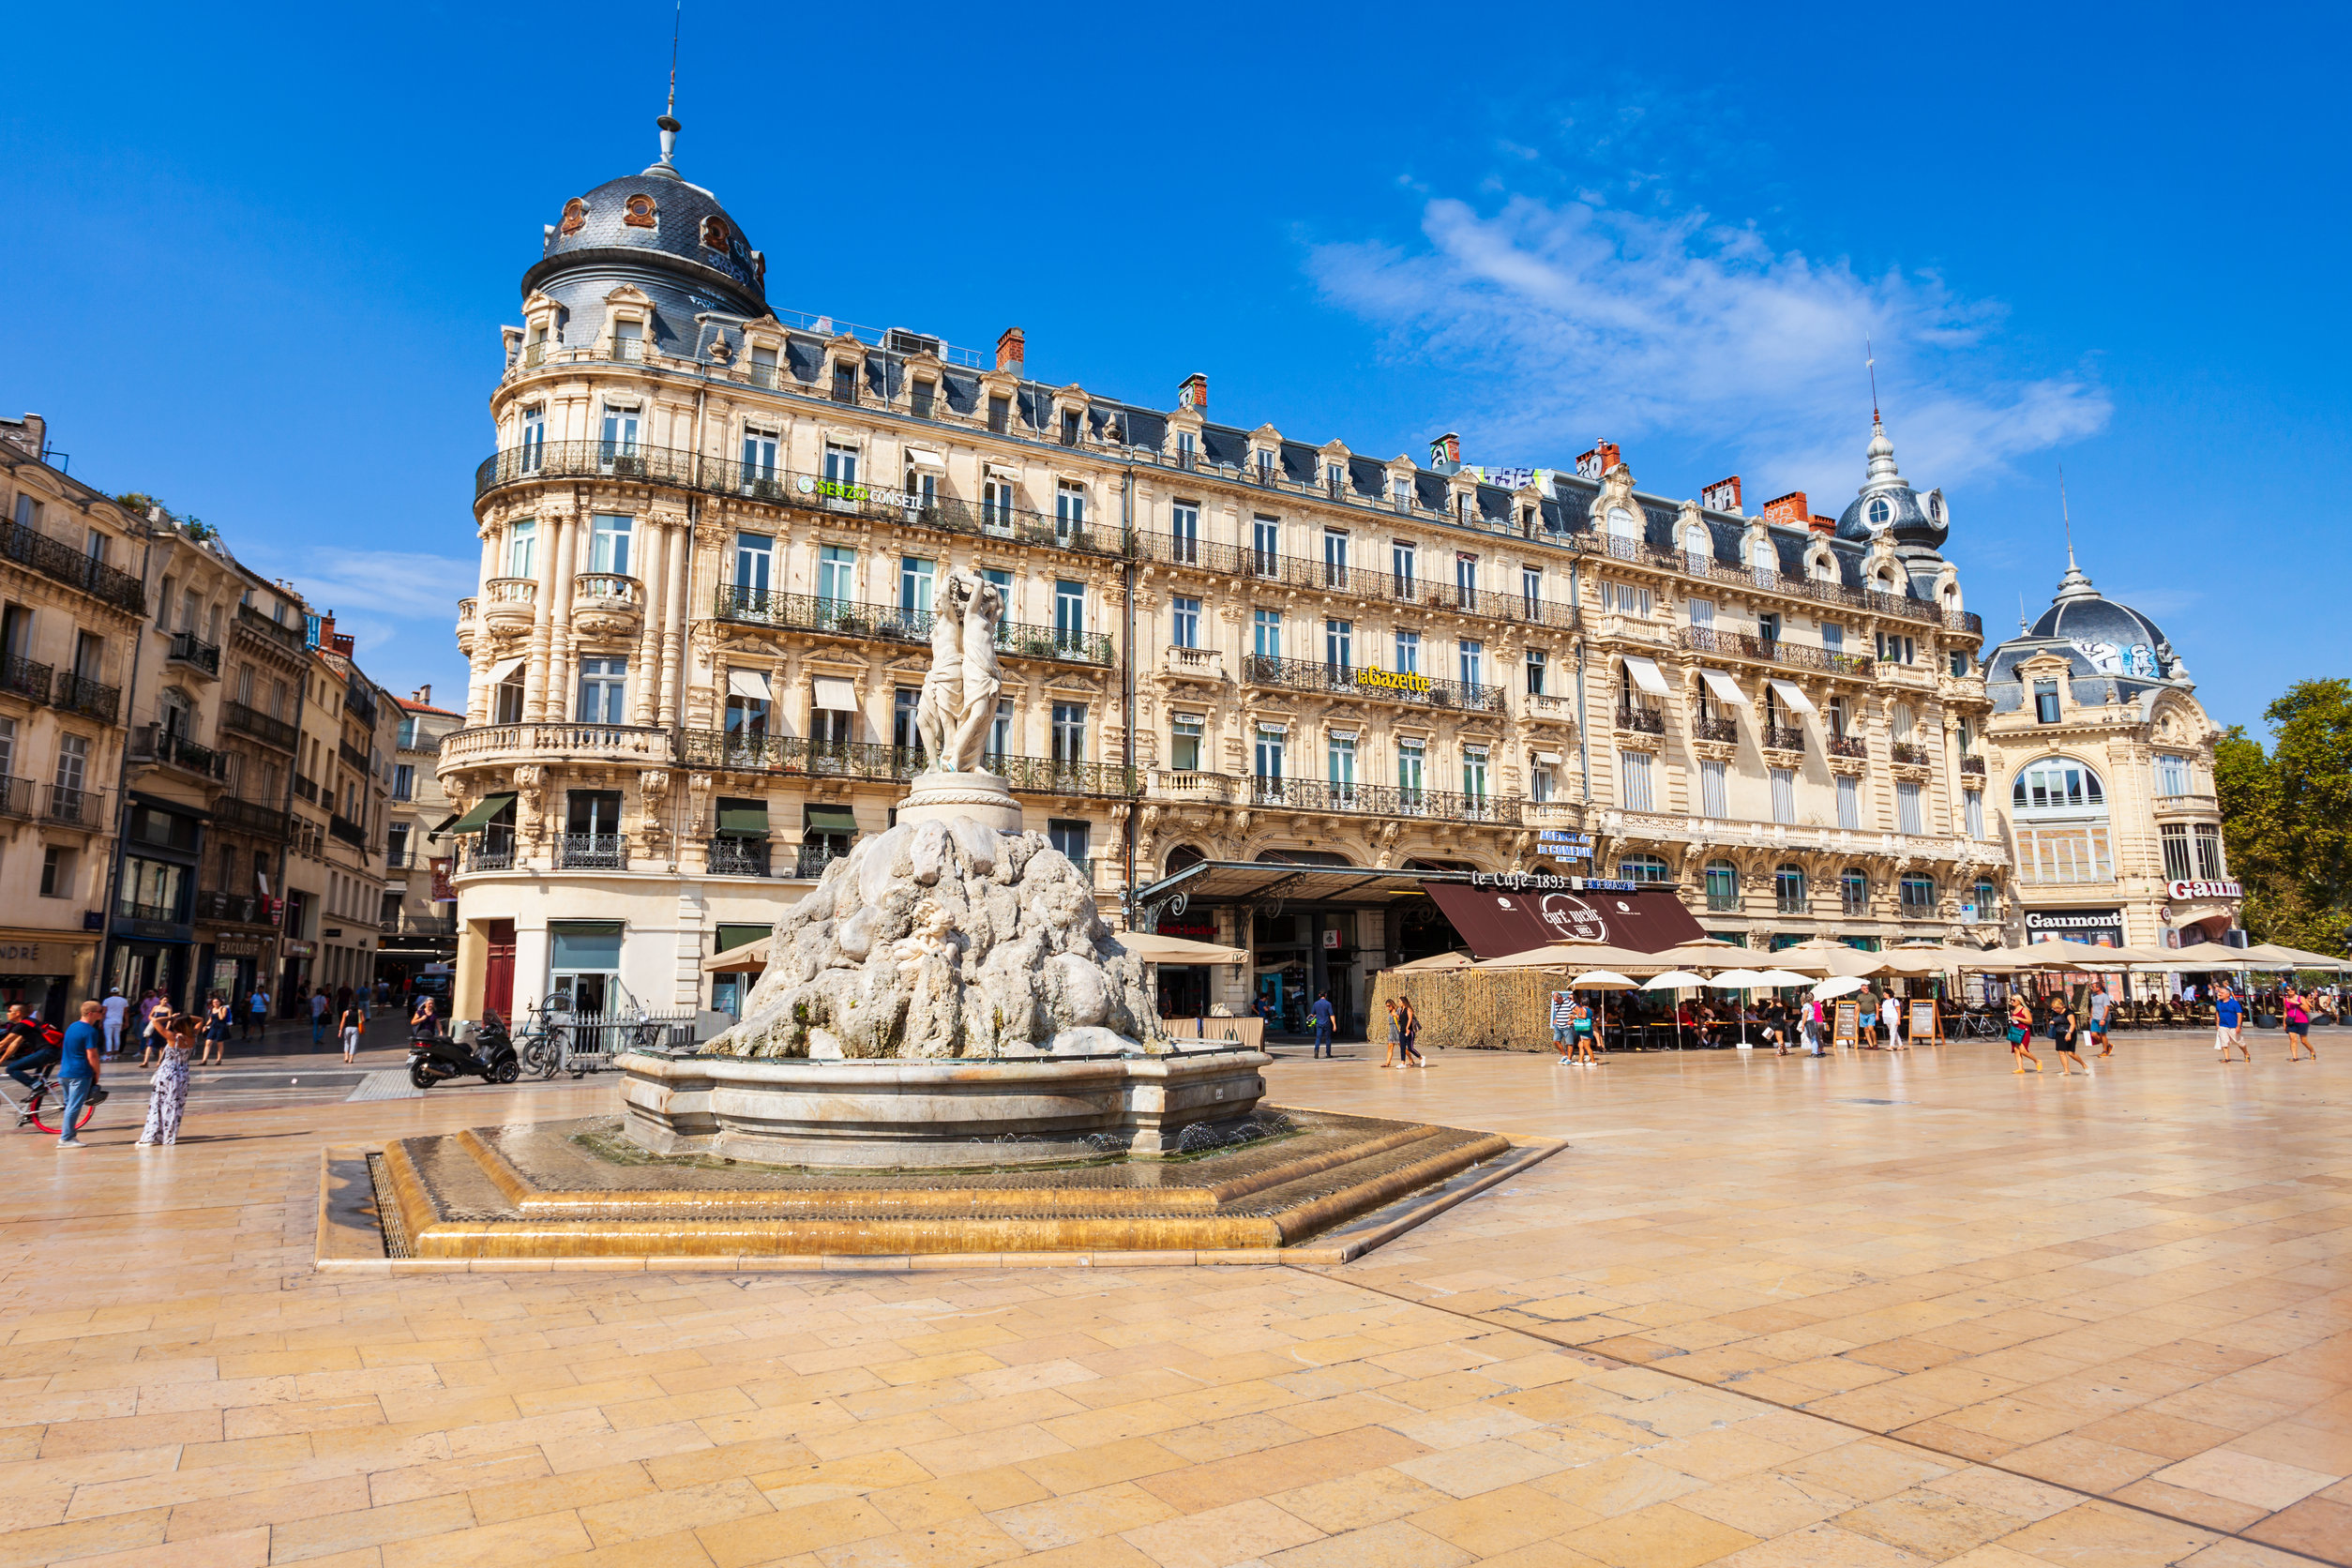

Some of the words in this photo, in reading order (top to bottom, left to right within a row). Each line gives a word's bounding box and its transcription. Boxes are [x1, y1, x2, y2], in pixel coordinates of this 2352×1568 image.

[817, 480, 868, 501] SENZO
[869, 490, 924, 511] CONSEIL
[1539, 829, 1577, 843] AGENCE
[1578, 833, 1591, 843] de
[1549, 845, 1593, 857] COMEDIE
[1536, 874, 1565, 889] 1893
[2026, 912, 2122, 928] Gaumont
[219, 941, 259, 954] EXCLUSIF
